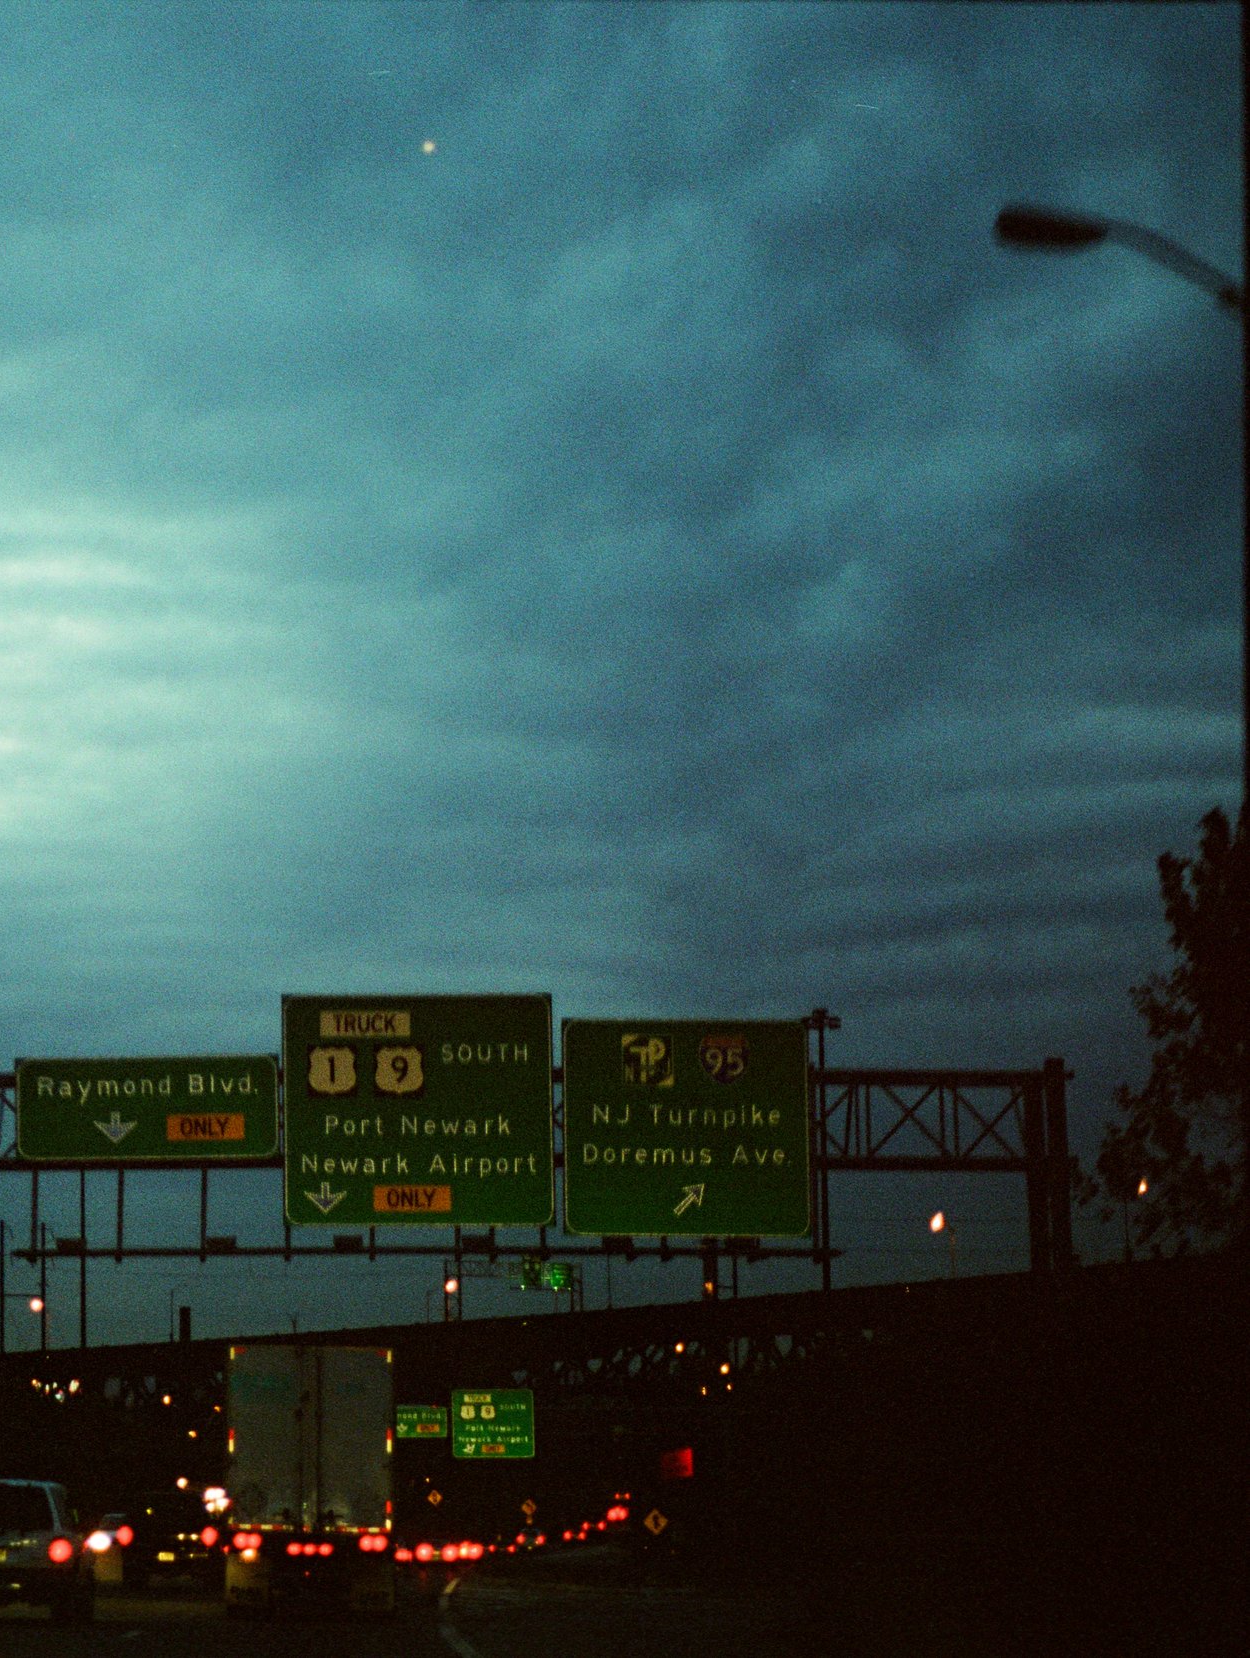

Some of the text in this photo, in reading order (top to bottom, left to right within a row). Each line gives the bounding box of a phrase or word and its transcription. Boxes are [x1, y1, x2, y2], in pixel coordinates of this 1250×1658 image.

[334, 1014, 397, 1033] TRUCK
[441, 1043, 528, 1064] SOUTH
[706, 1047, 744, 1076] 95
[327, 1055, 336, 1084] 1
[391, 1055, 409, 1084] 9
[37, 1073, 258, 1105] Raymond Blvd.
[180, 1117, 229, 1137] ONLY
[325, 1114, 511, 1136] Port Newark
[592, 1103, 781, 1130] NJ Turnpike
[301, 1153, 537, 1178] Newark Airport
[583, 1143, 712, 1165] Doremus
[386, 1189, 436, 1207] ONLY
